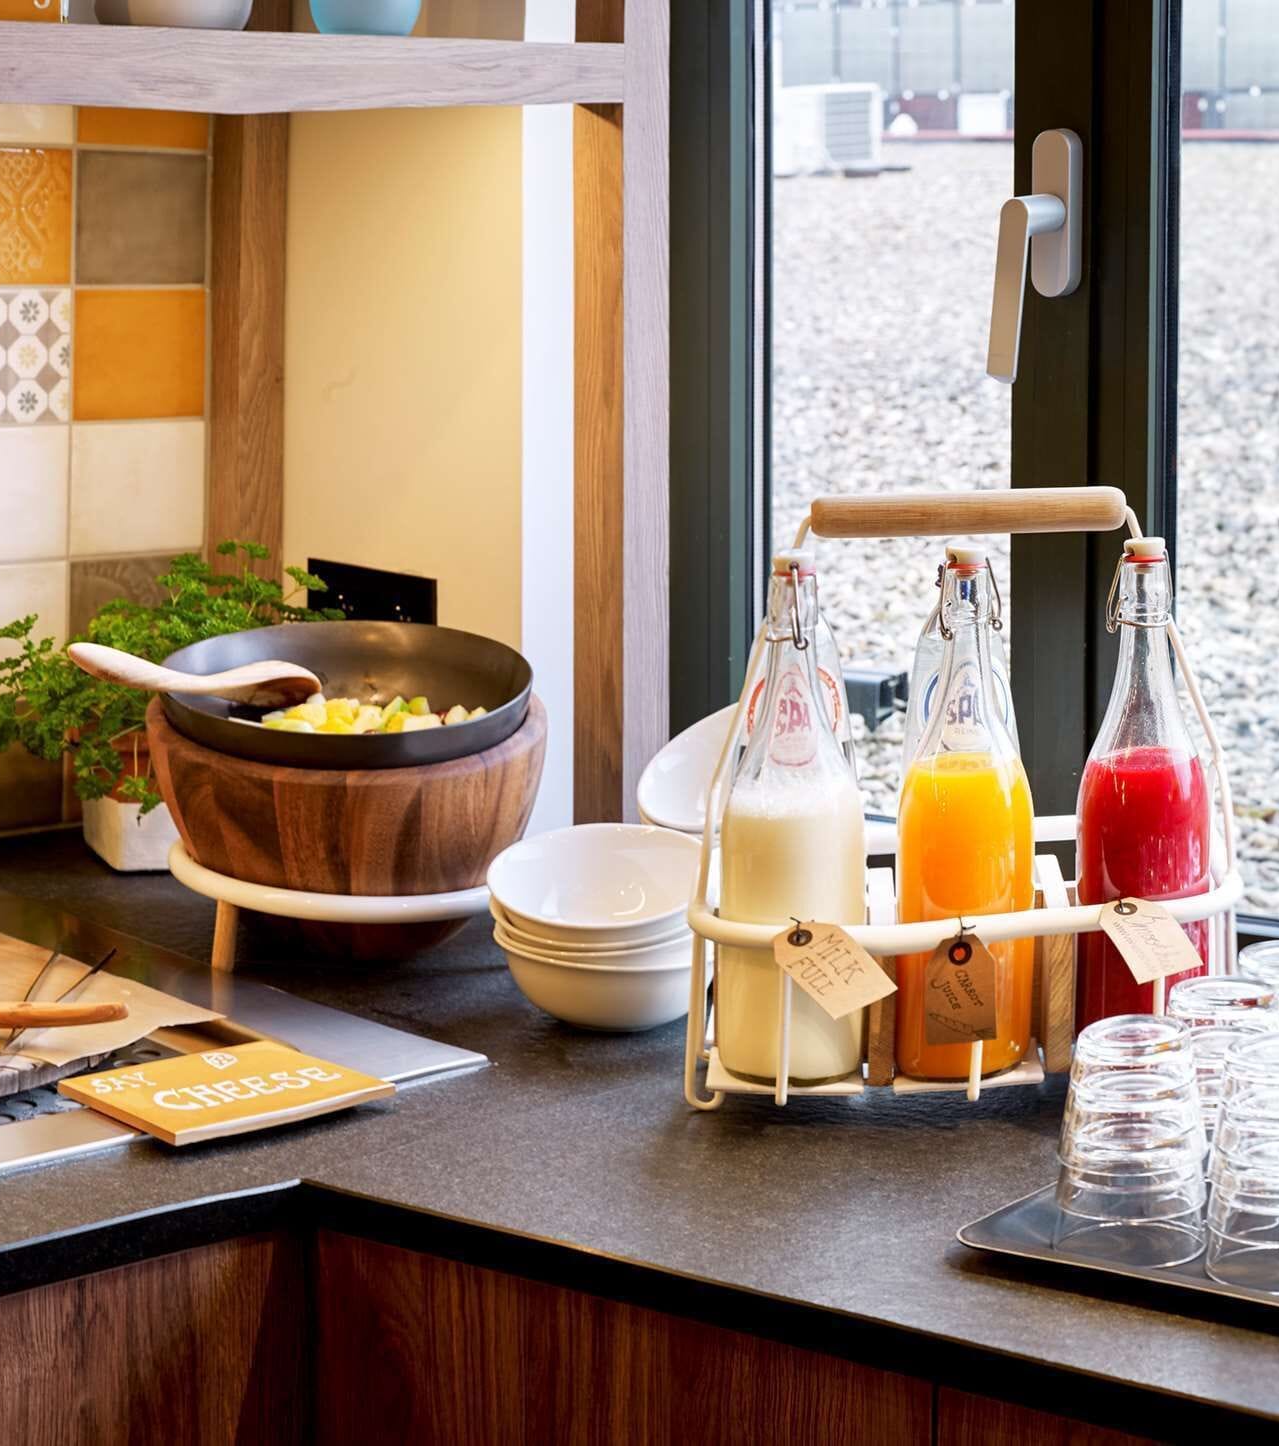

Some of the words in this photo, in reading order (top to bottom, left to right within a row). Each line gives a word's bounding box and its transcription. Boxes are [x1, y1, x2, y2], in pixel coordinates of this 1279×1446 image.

[785, 956, 835, 997] FULL
[954, 969, 985, 1008] CARROT
[90, 1071, 157, 1095] SAY
[152, 1066, 342, 1111] CHEESE
